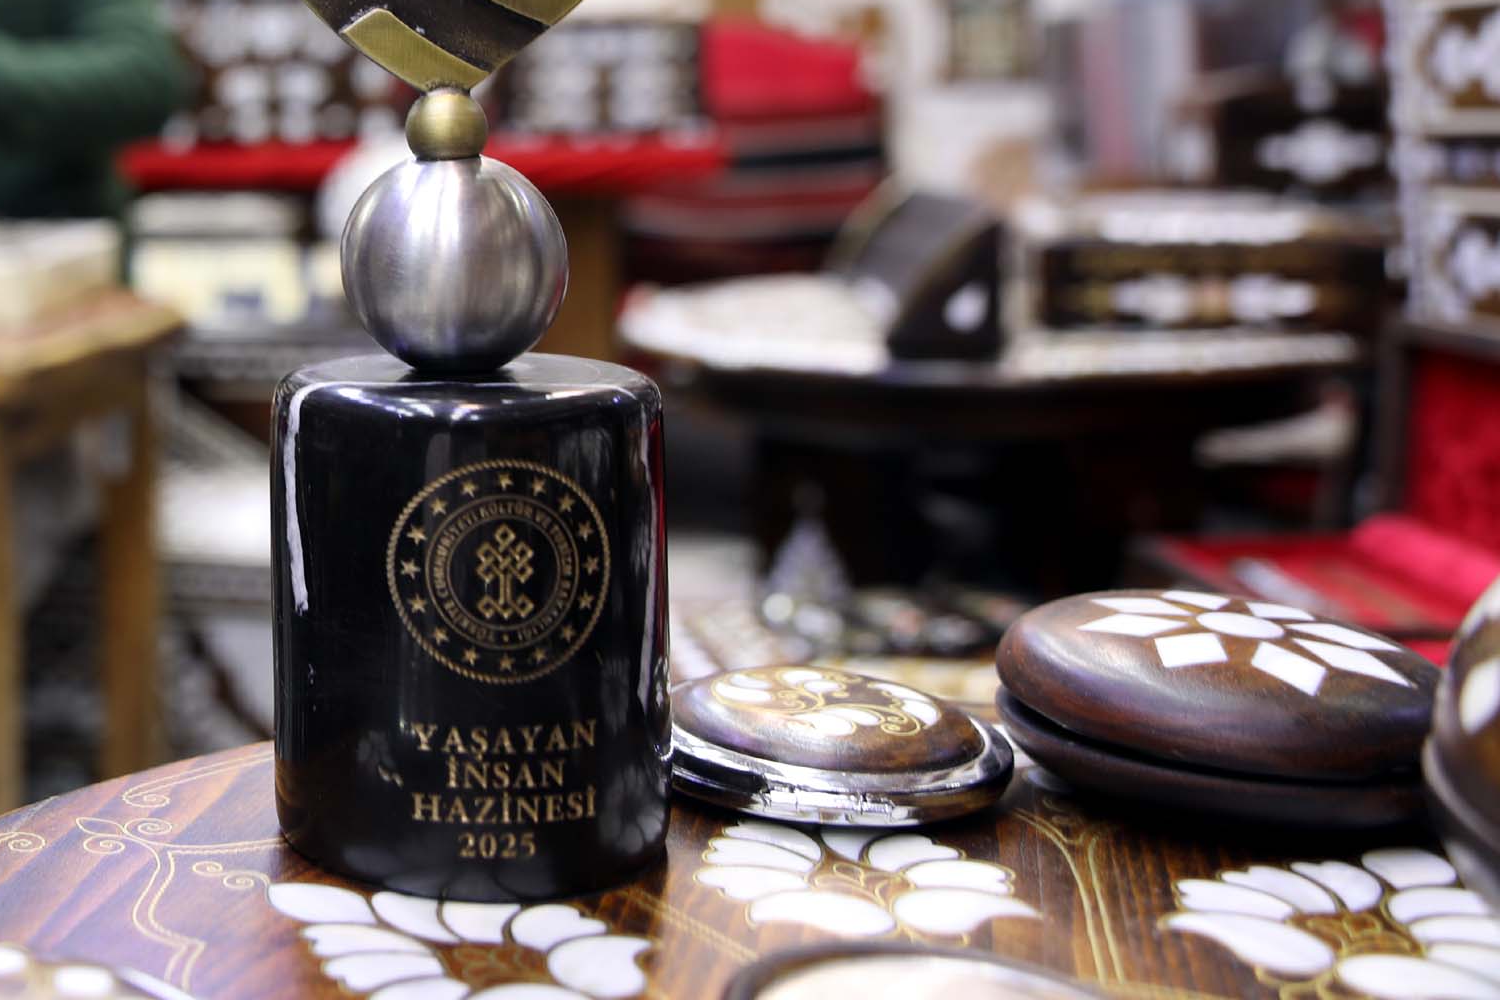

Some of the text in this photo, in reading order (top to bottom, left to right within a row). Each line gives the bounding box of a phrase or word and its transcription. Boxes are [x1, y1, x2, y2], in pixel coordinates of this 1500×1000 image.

[410, 718, 597, 761] YAŞAYAN
[445, 754, 566, 789] İNSAN
[411, 785, 597, 824] HAZİNESİ
[458, 831, 537, 859] 2025
